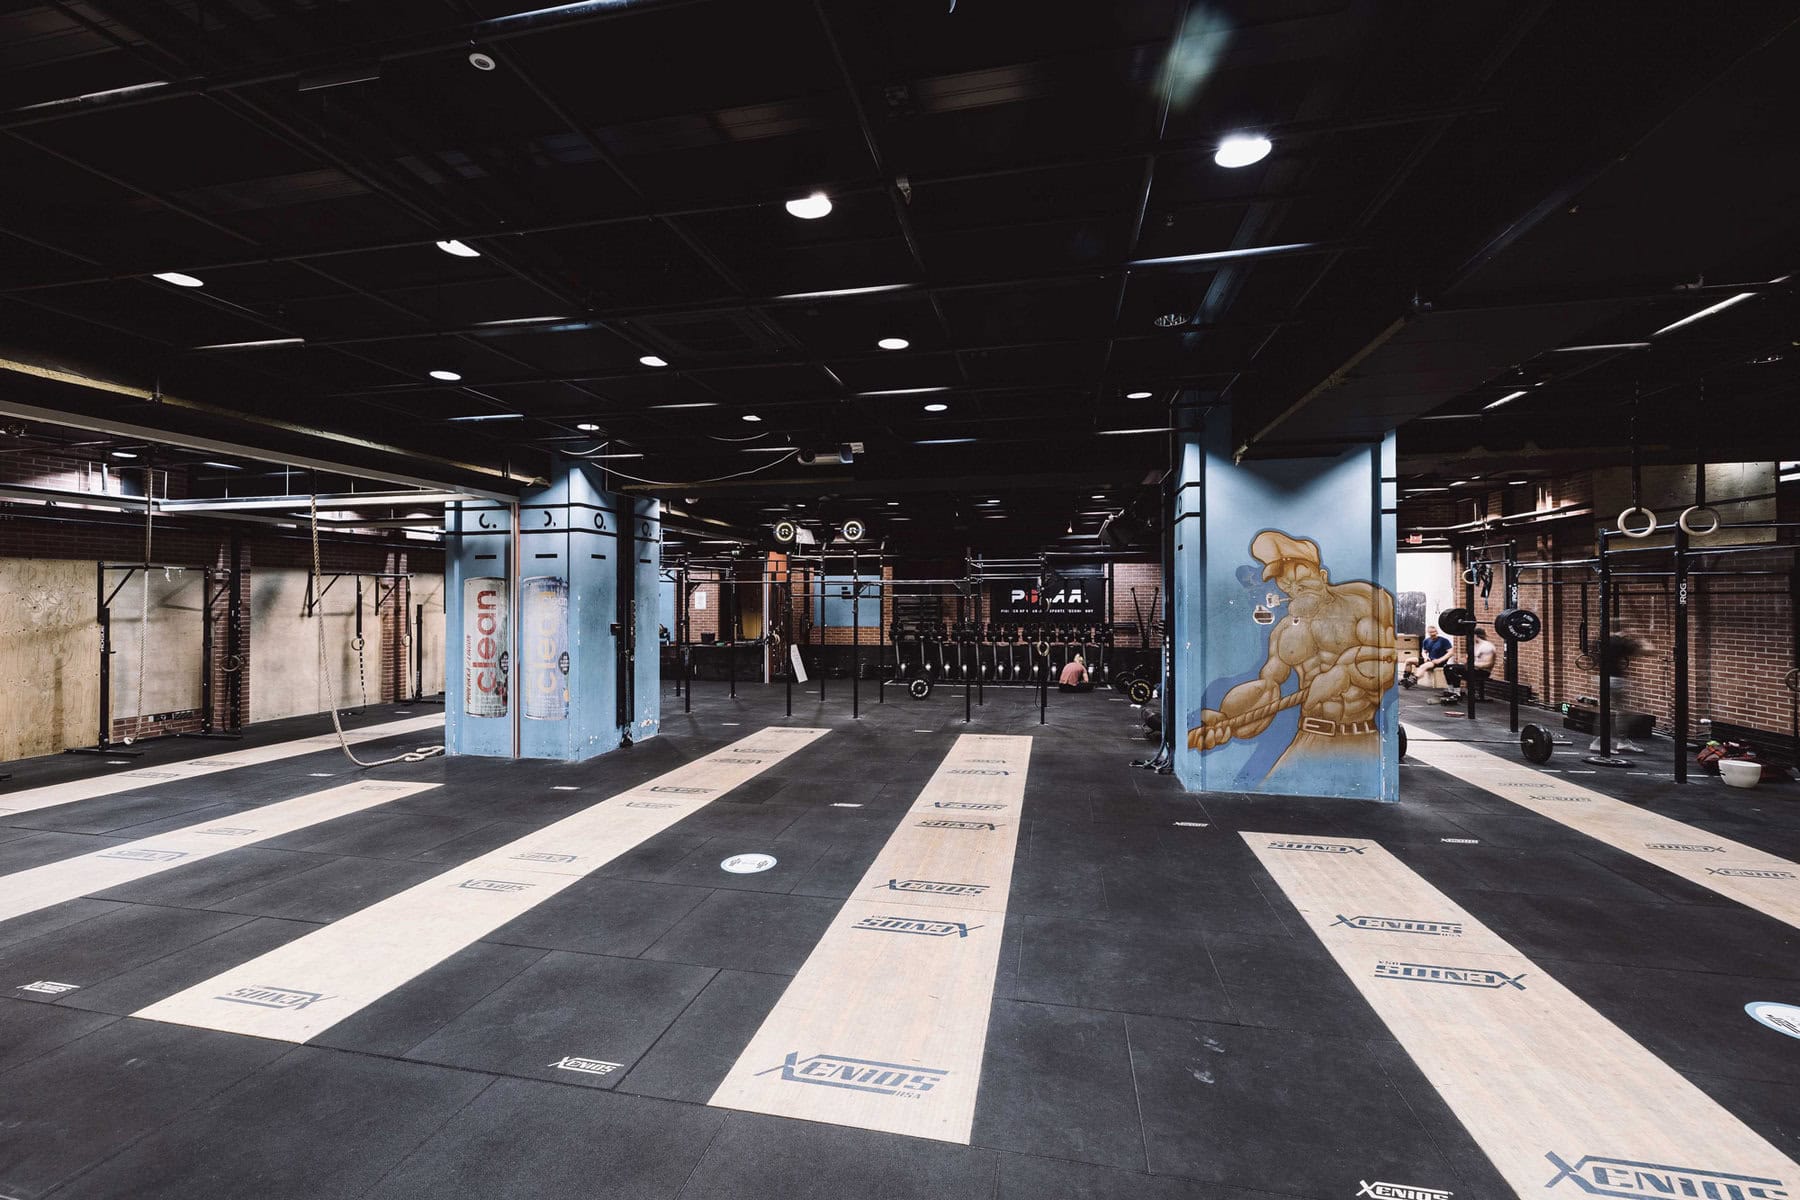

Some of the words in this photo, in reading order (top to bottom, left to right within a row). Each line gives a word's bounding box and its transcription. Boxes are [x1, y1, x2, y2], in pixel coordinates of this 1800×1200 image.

[1011, 589, 1089, 604] POAR
[473, 591, 496, 692] clean
[851, 917, 985, 938] XENIOS
[1330, 914, 1463, 935] XENIOS
[1374, 962, 1527, 990] XENIOS
[547, 1056, 625, 1075] XENIOS
[754, 1051, 950, 1096] XENIOS
